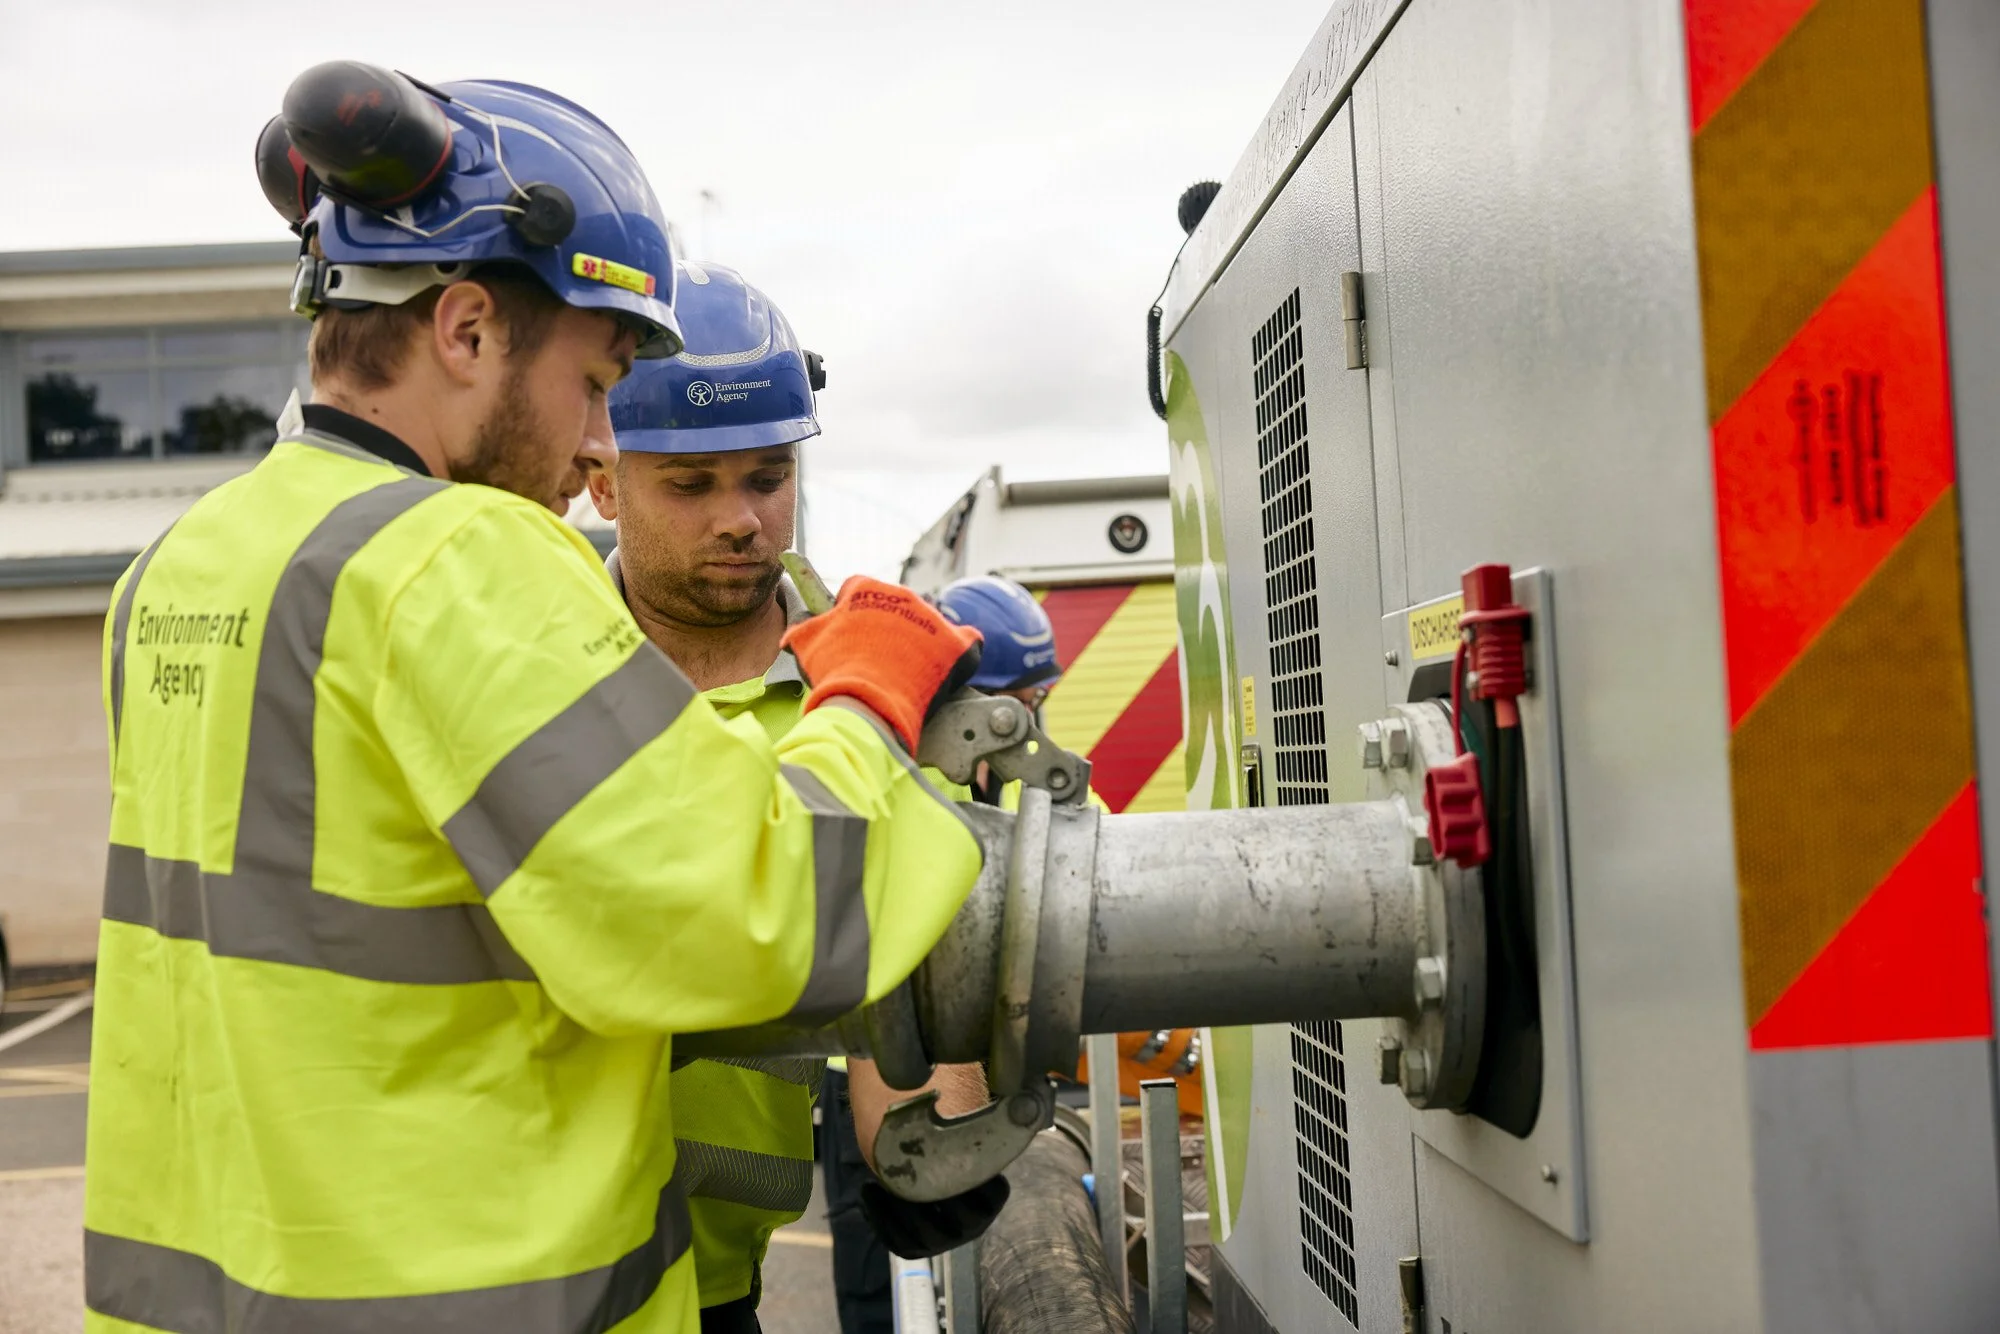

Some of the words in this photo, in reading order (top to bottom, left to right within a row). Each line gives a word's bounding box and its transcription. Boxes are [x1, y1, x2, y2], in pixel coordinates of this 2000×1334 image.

[715, 379, 771, 392] Environment
[716, 391, 749, 403] Agency
[136, 603, 249, 648] Environment
[149, 653, 206, 708] Agency
